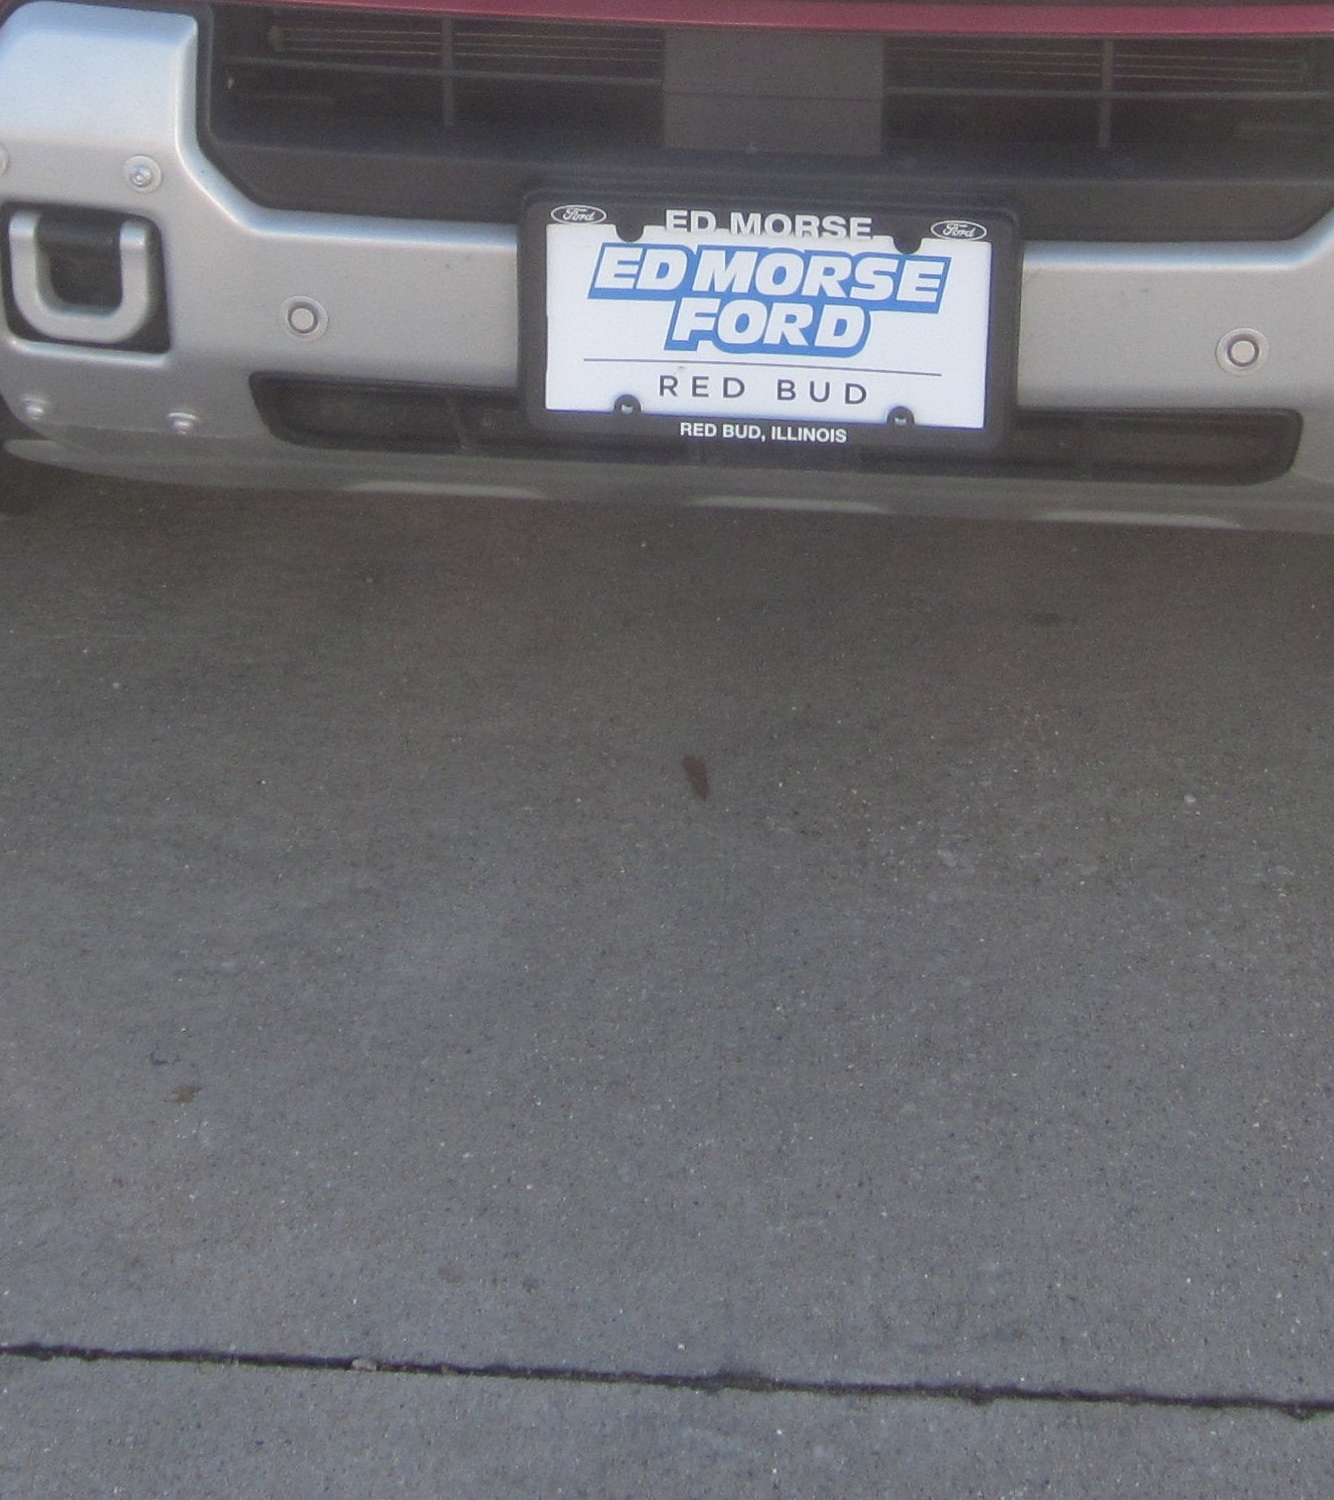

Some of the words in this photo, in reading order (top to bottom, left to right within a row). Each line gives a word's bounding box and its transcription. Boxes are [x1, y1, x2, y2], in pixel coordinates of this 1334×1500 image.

[666, 209, 717, 233] ED
[730, 211, 873, 240] MORSE
[591, 244, 688, 295] ED
[690, 247, 950, 308] MORSE
[666, 298, 871, 354] FORD
[659, 375, 745, 398] RED
[777, 380, 867, 405] BUD
[681, 422, 717, 437] RED
[723, 424, 766, 442] BUD,
[771, 426, 847, 443] ILLINOIS
